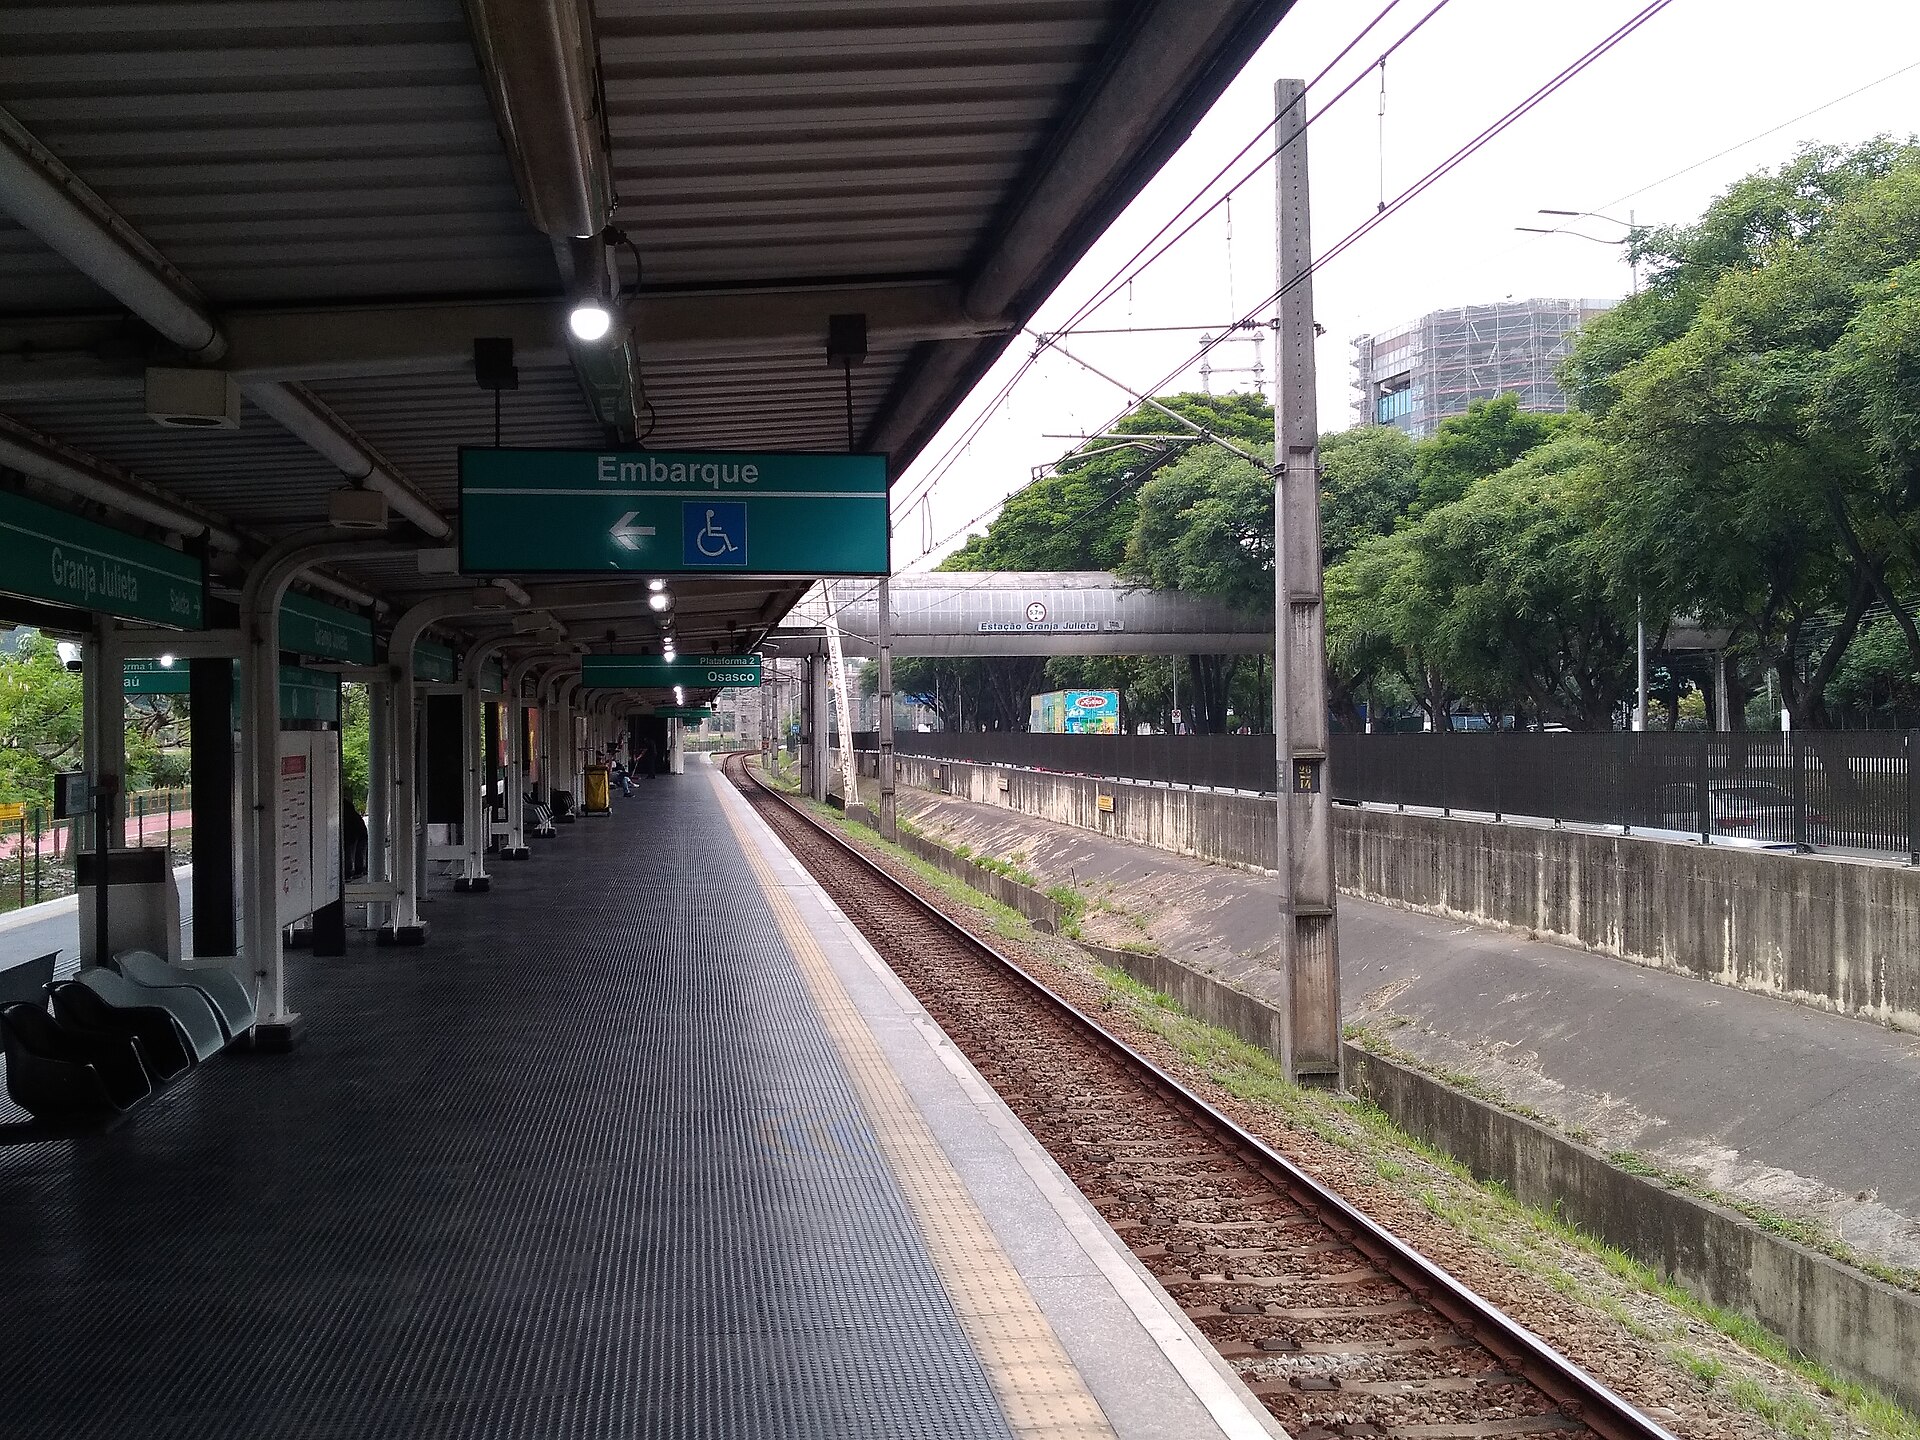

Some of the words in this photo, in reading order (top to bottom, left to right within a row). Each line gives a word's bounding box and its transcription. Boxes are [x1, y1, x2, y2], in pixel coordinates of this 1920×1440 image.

[597, 455, 760, 489] Embarque
[51, 546, 96, 601] Granja
[99, 560, 138, 602] Julieta
[981, 622, 1022, 631] Estação
[1026, 622, 1059, 631] Granja
[1063, 622, 1096, 630] Julieta
[700, 657, 747, 665] Plataforma
[749, 657, 755, 665] 2
[707, 671, 755, 682] Osasco
